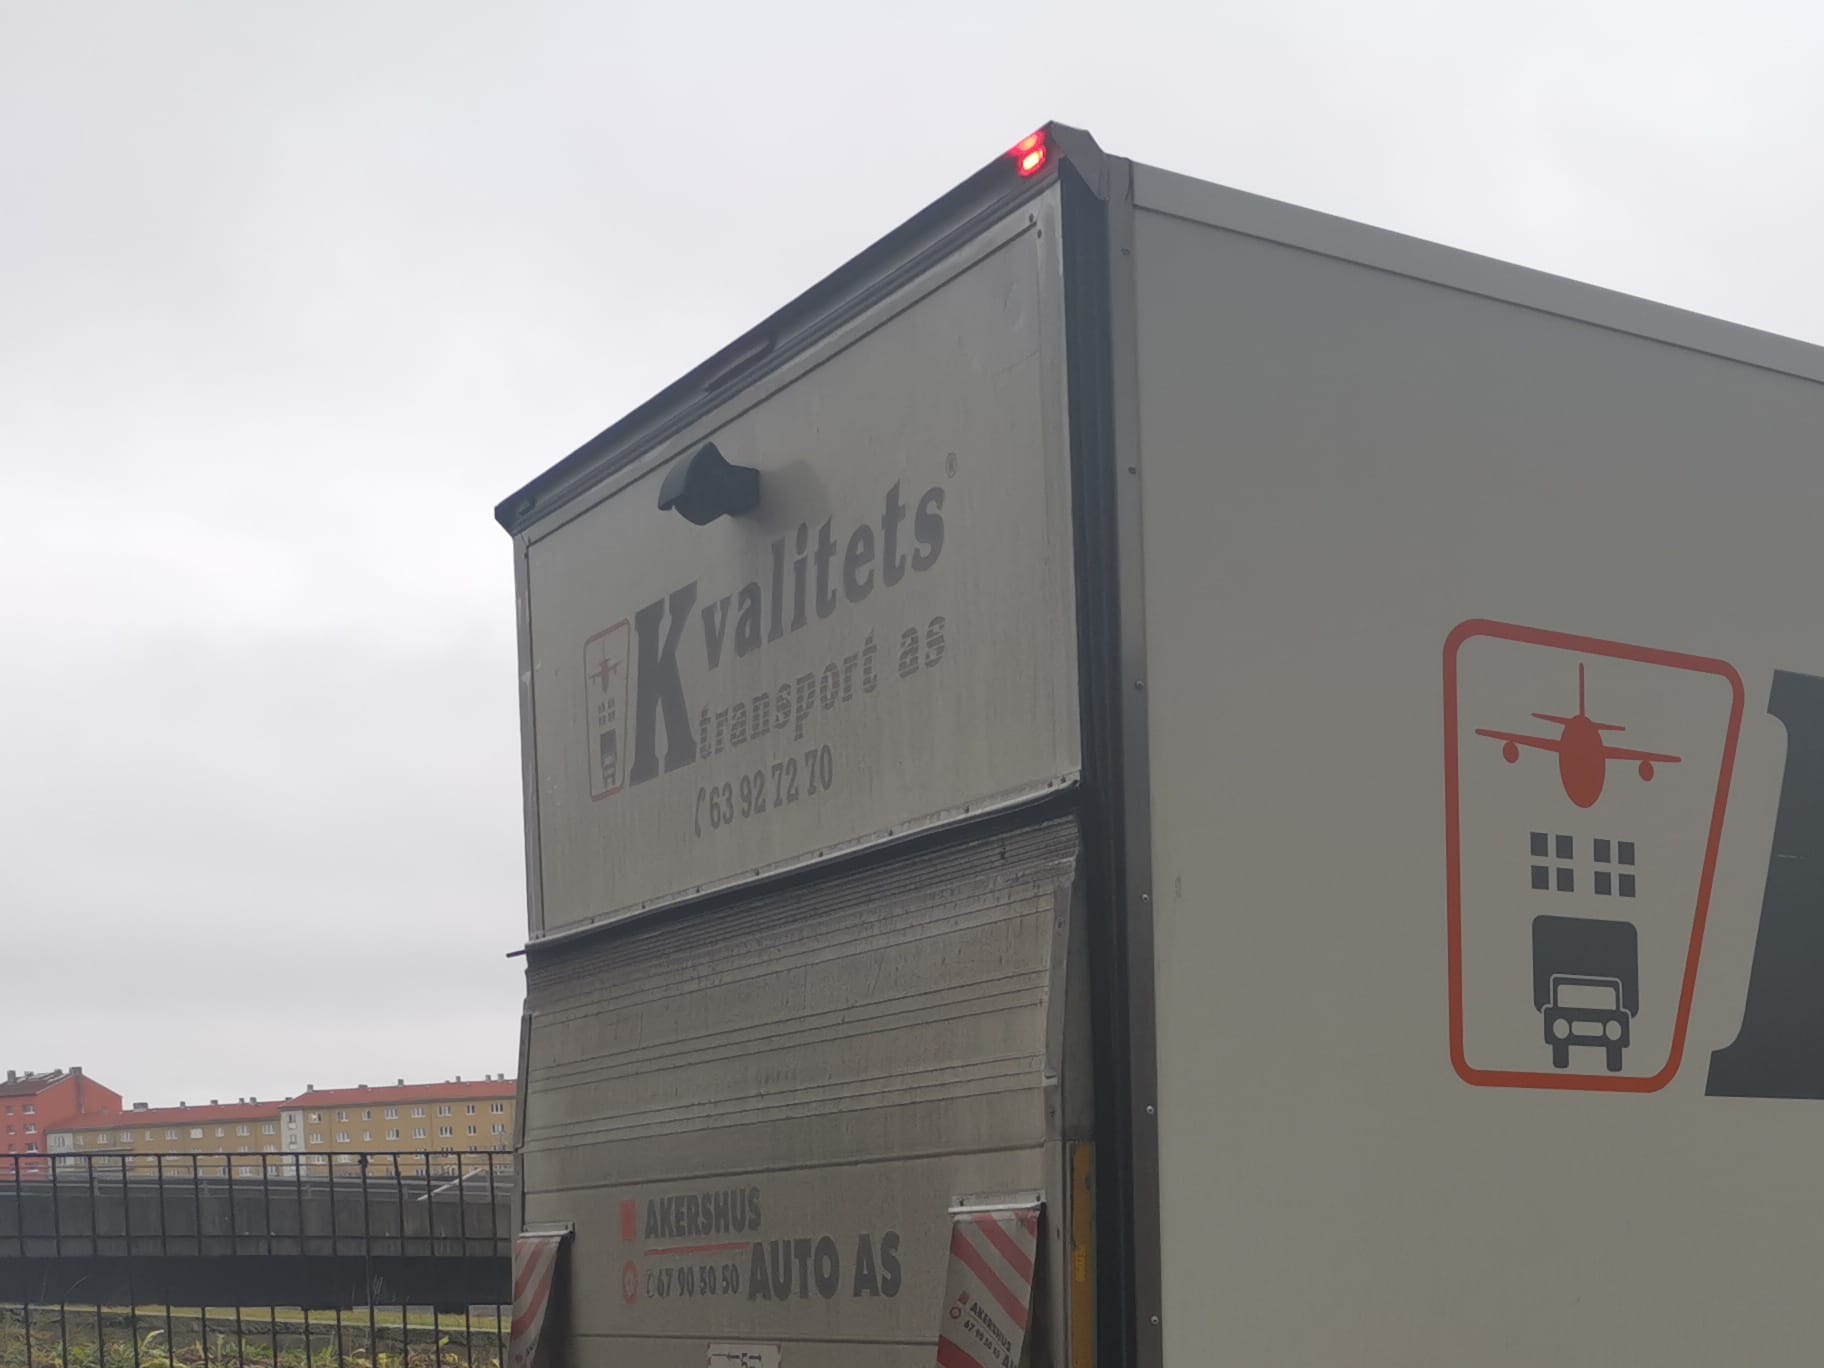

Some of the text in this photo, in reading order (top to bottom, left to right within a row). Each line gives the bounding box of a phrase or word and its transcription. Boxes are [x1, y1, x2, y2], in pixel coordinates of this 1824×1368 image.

[697, 615, 945, 760] transport as
[709, 744, 832, 829] 63 92 72 70
[644, 1186, 761, 1240] AKERSHUS
[656, 1263, 739, 1298] 67 90 50 50
[749, 1230, 901, 1301] AUTO AS
